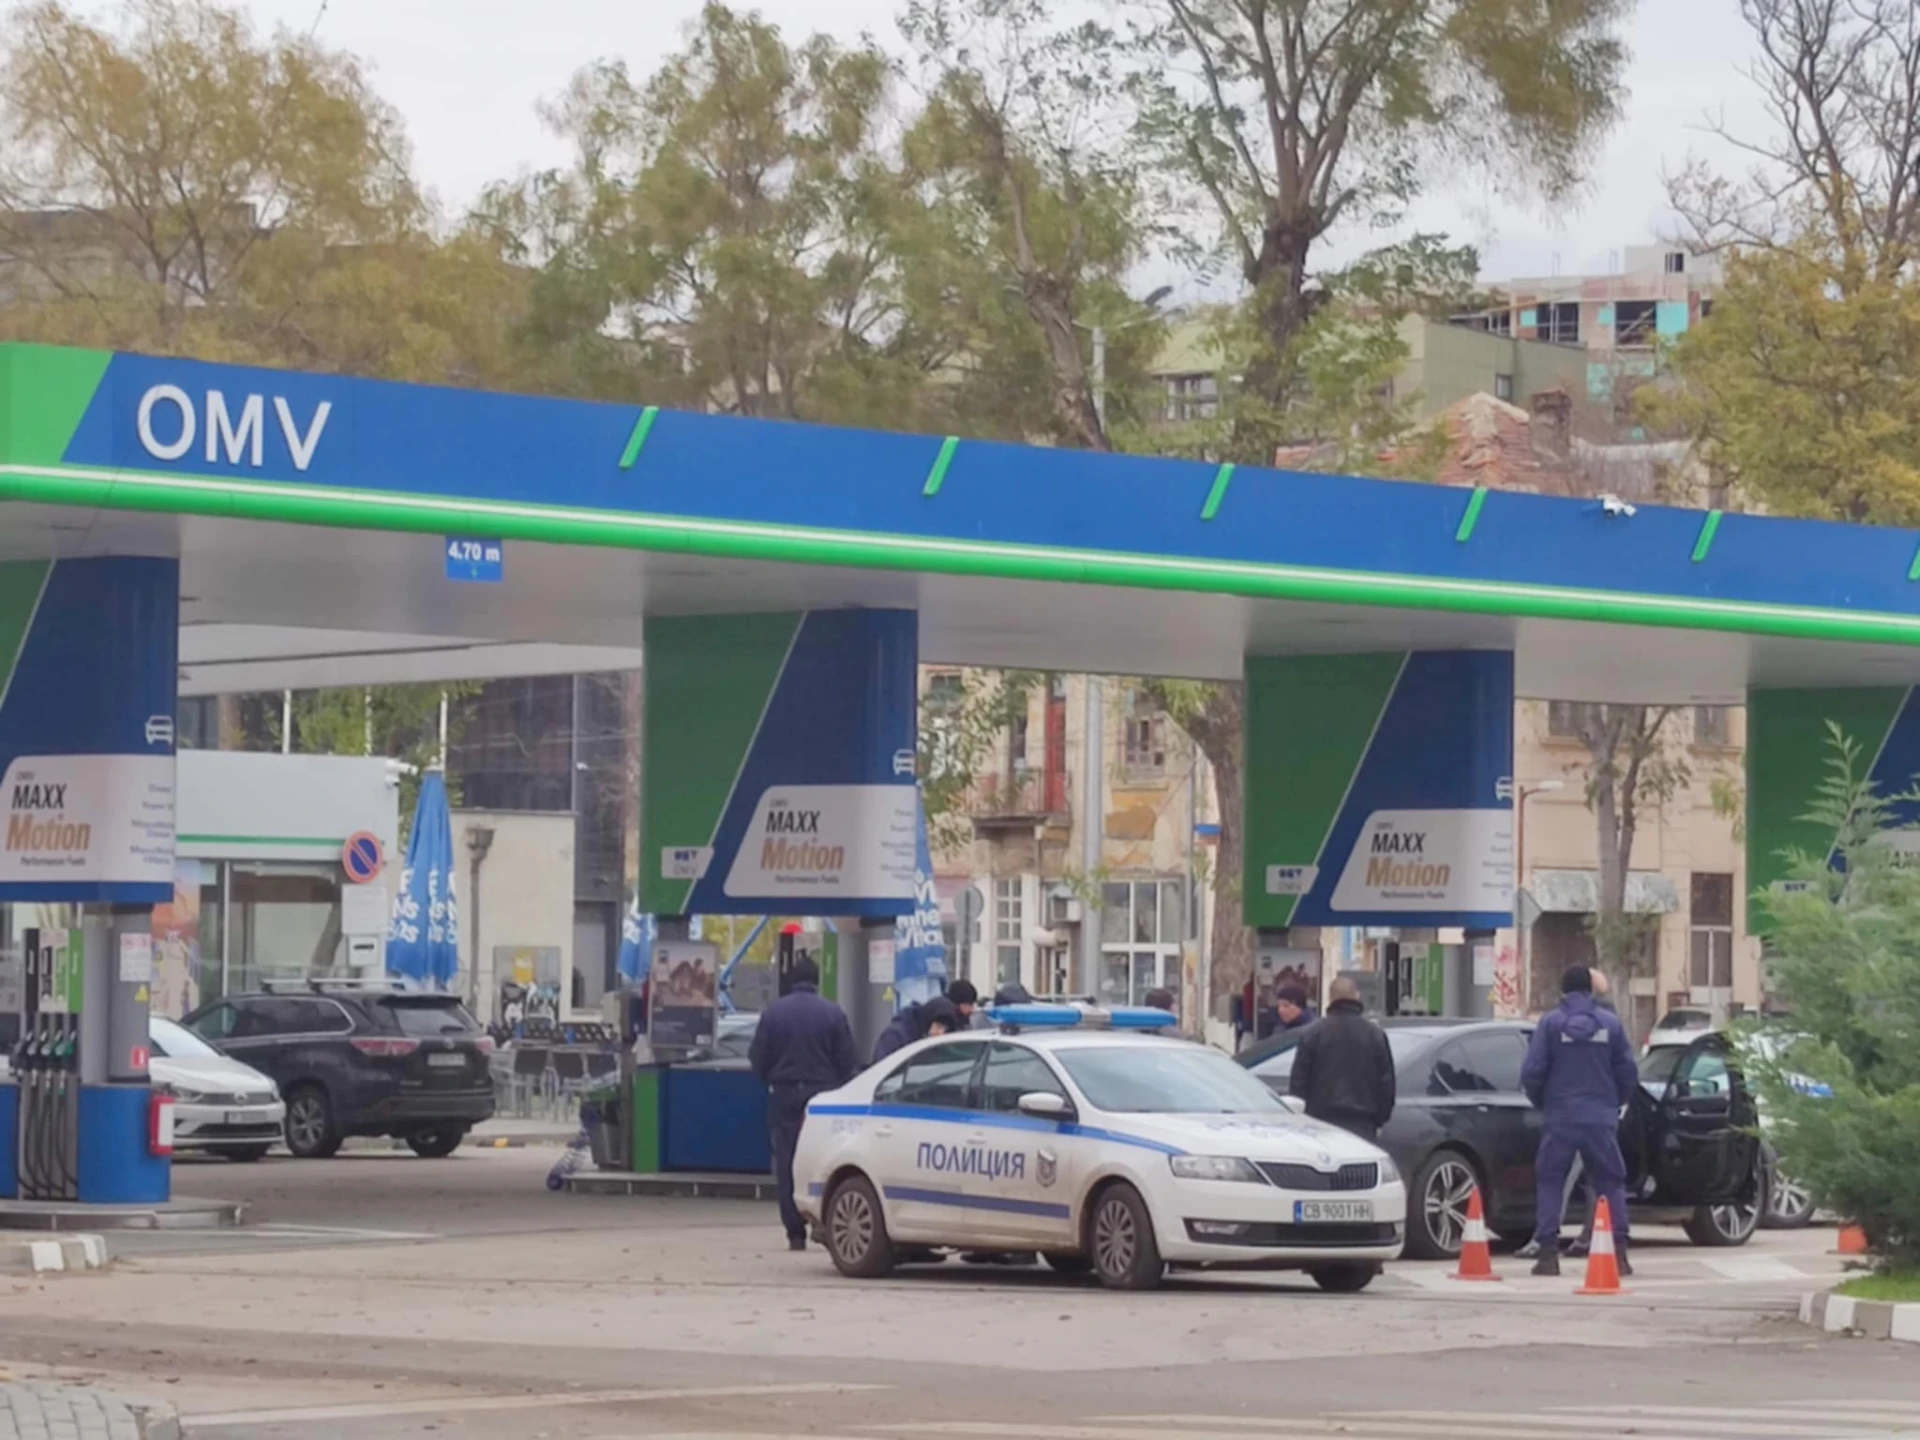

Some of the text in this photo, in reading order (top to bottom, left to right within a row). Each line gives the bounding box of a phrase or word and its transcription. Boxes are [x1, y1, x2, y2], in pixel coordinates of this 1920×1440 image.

[138, 384, 332, 471] OMV
[448, 541, 500, 562] 4.70 m
[11, 783, 67, 810] MAXX
[6, 813, 91, 851] Motion
[765, 810, 821, 834] MAXX
[760, 837, 845, 871] Motion
[1371, 832, 1426, 854] MAXX
[1365, 855, 1450, 887] Motion
[917, 1142, 1026, 1182] ПОЛИЦИЯ
[1304, 1203, 1320, 1219] CB
[1322, 1203, 1352, 1219] 9001
